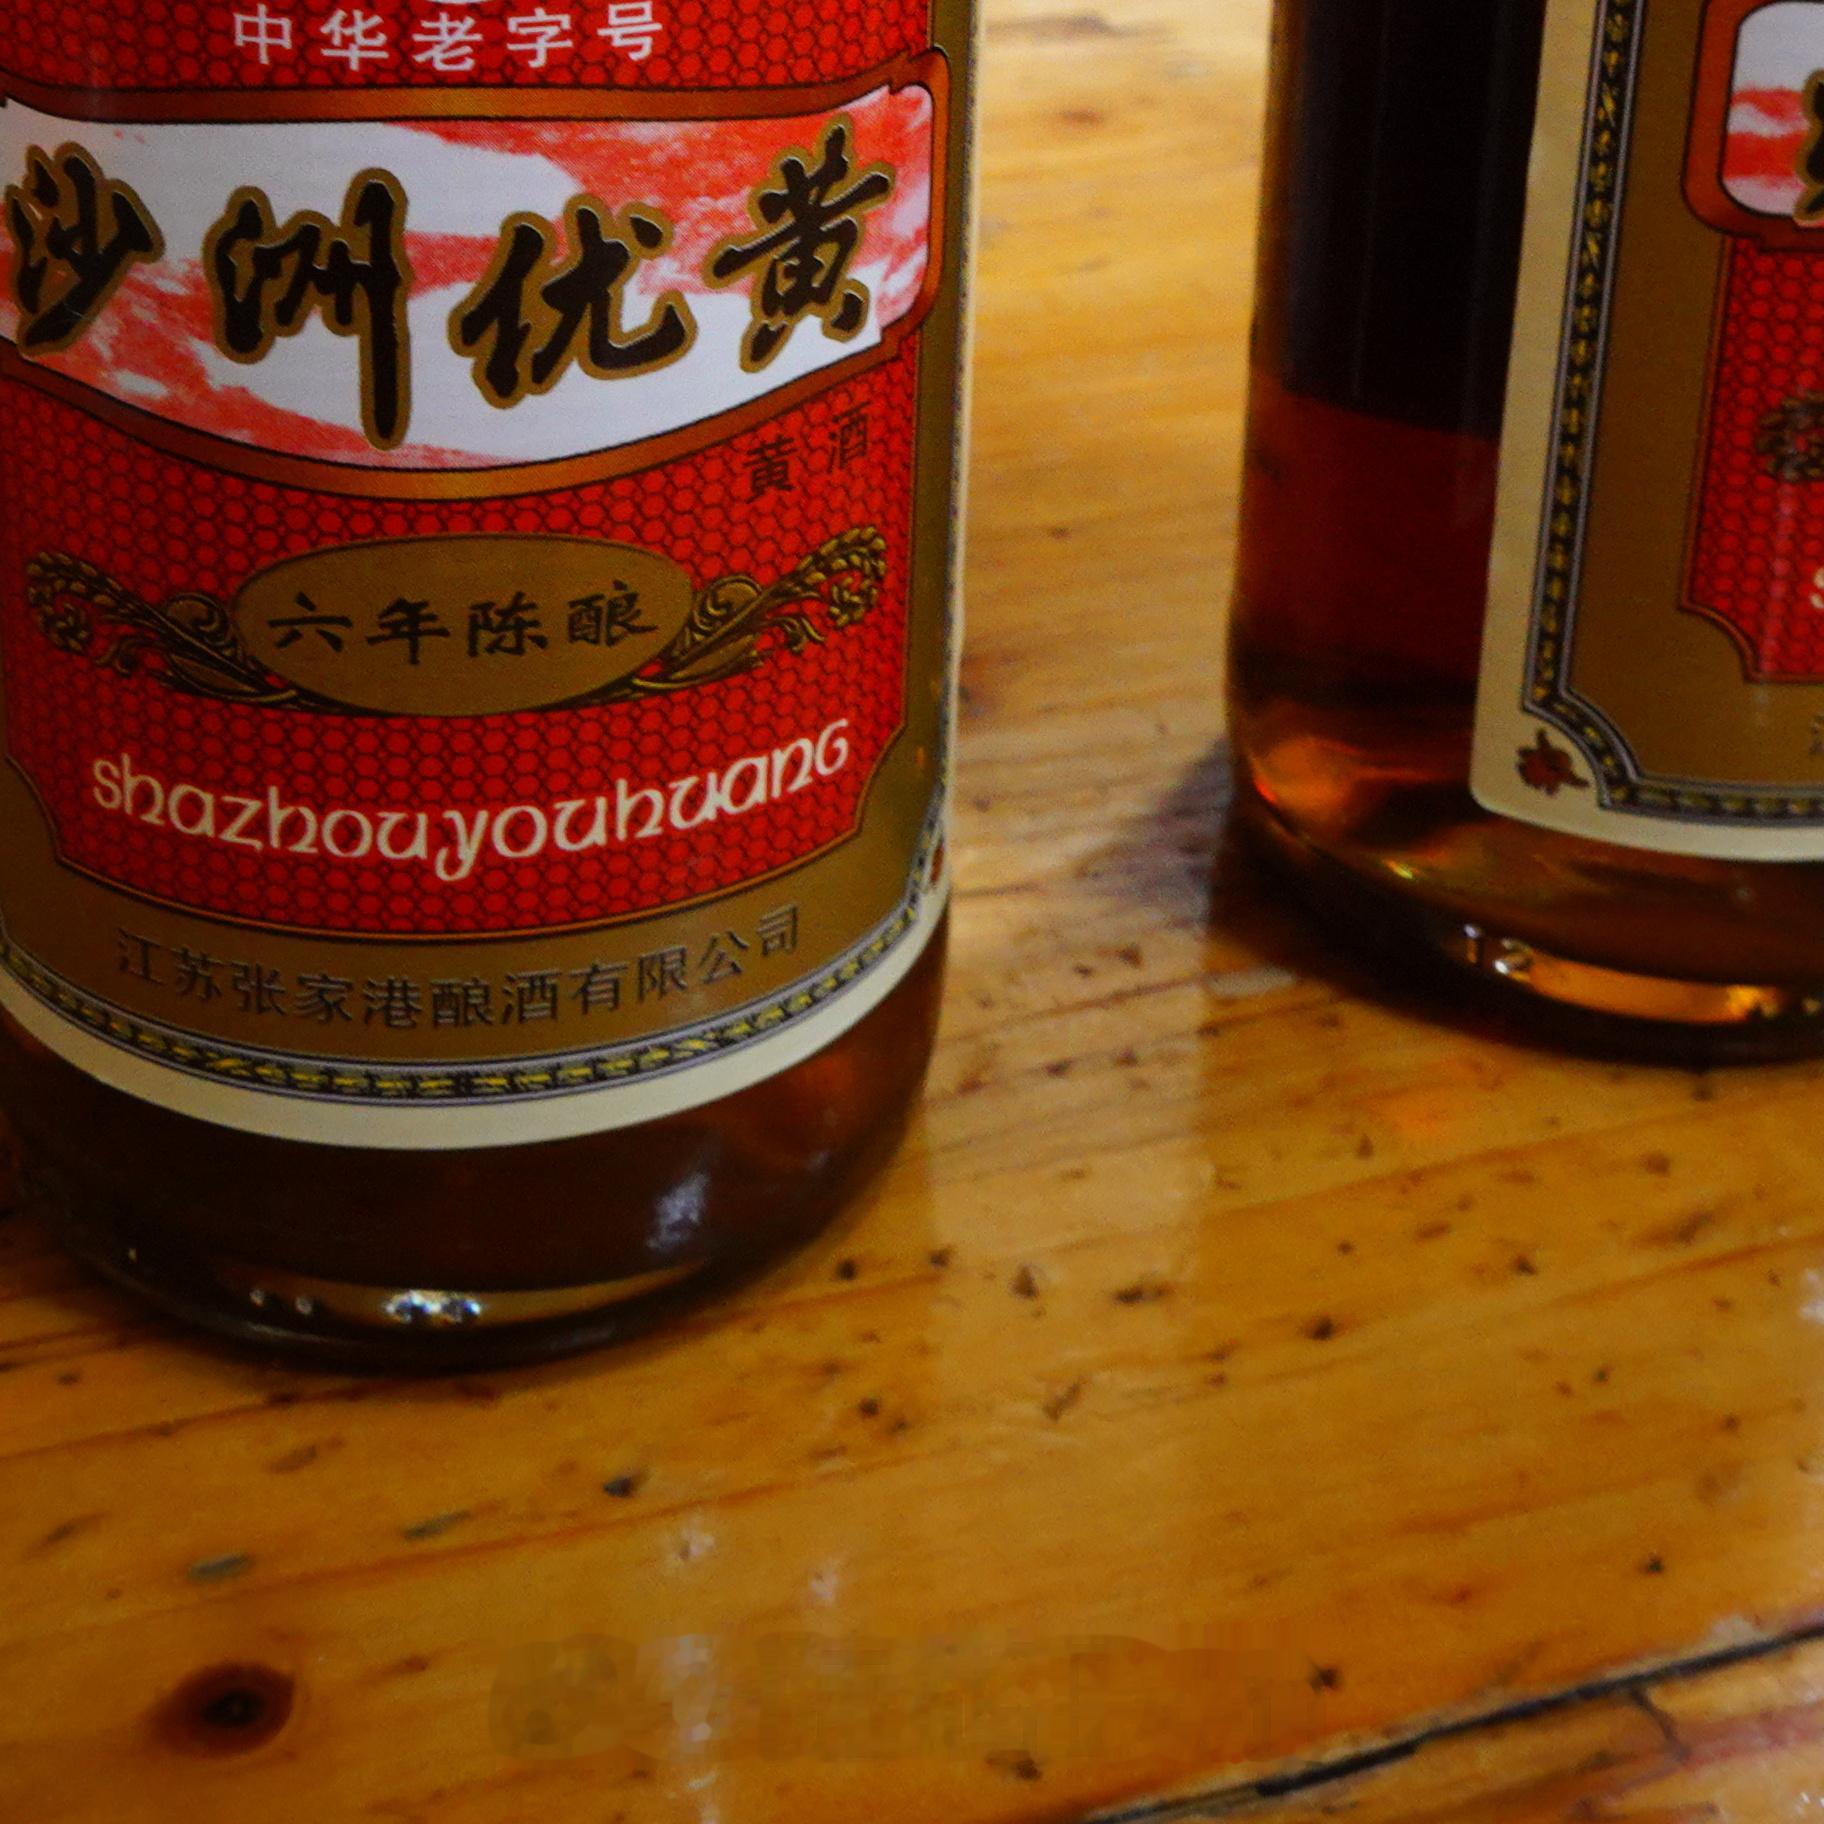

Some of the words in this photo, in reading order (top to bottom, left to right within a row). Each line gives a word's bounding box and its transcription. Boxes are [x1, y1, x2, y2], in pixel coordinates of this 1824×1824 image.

[233, 1, 664, 72] 中华老字号
[4, 116, 890, 449] 沙洲优黄
[267, 581, 658, 663] 六年陈酿
[114, 903, 800, 1030] 江苏张家港酿酒有限公司
